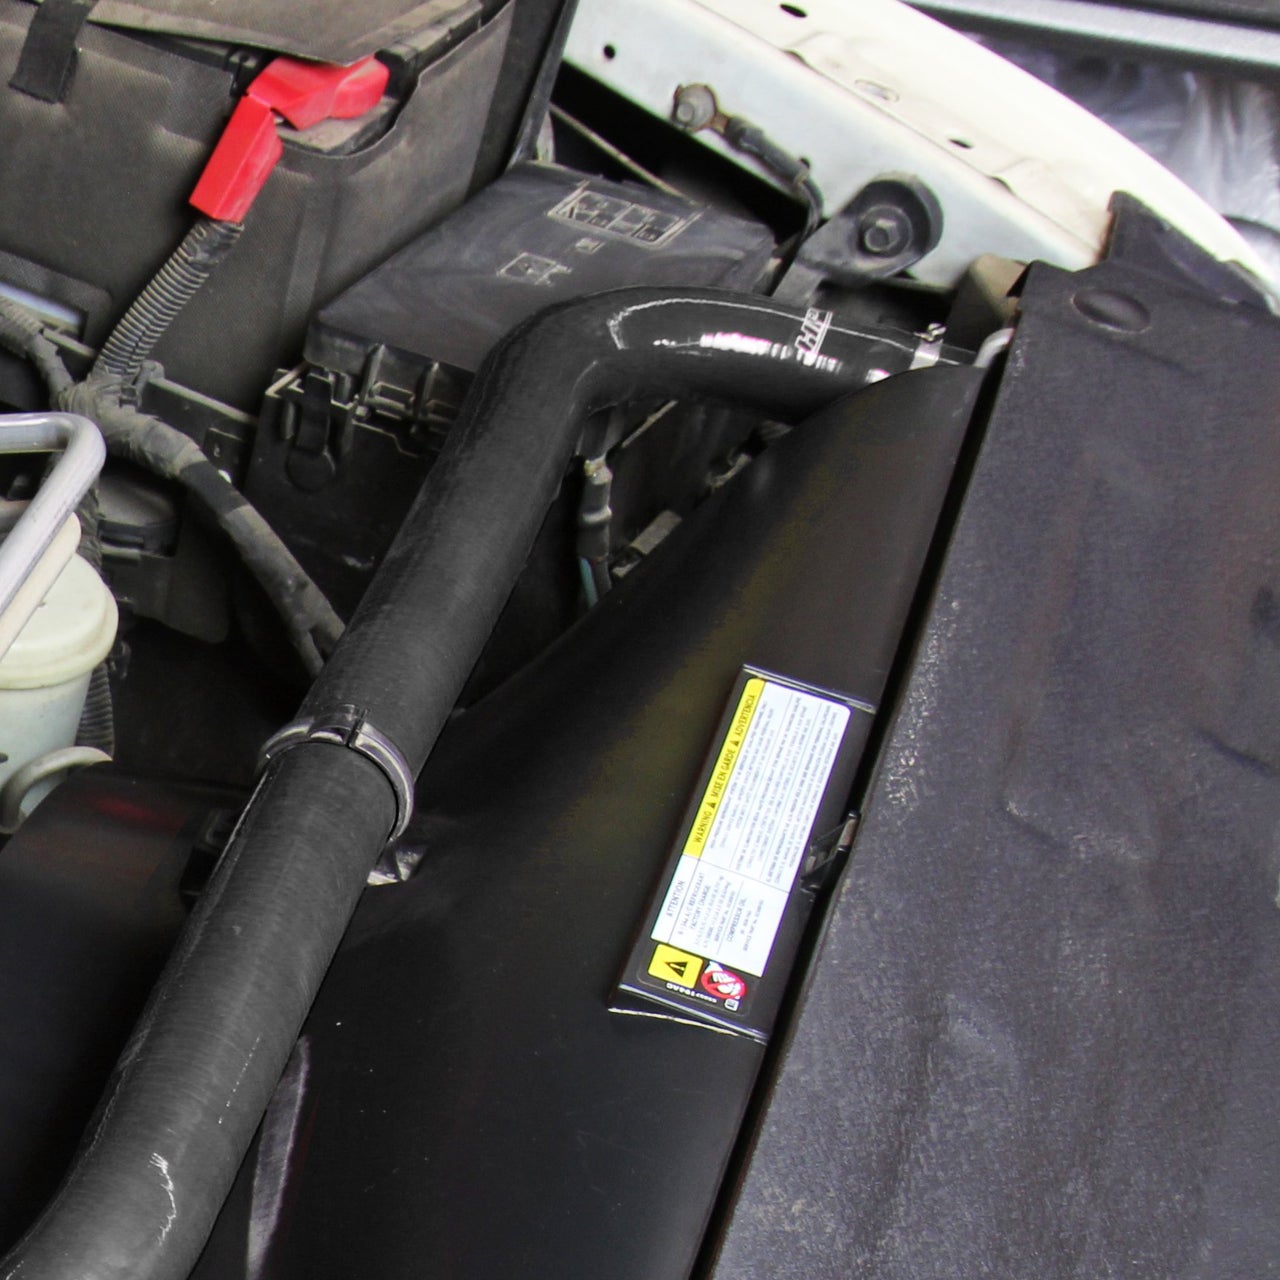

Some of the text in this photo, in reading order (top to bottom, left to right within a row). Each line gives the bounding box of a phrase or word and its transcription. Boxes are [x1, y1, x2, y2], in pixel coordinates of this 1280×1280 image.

[693, 692, 757, 844] WARNING MISE EN GARDE ADVERTENCIA
[665, 878, 686, 918] ATTENTION
